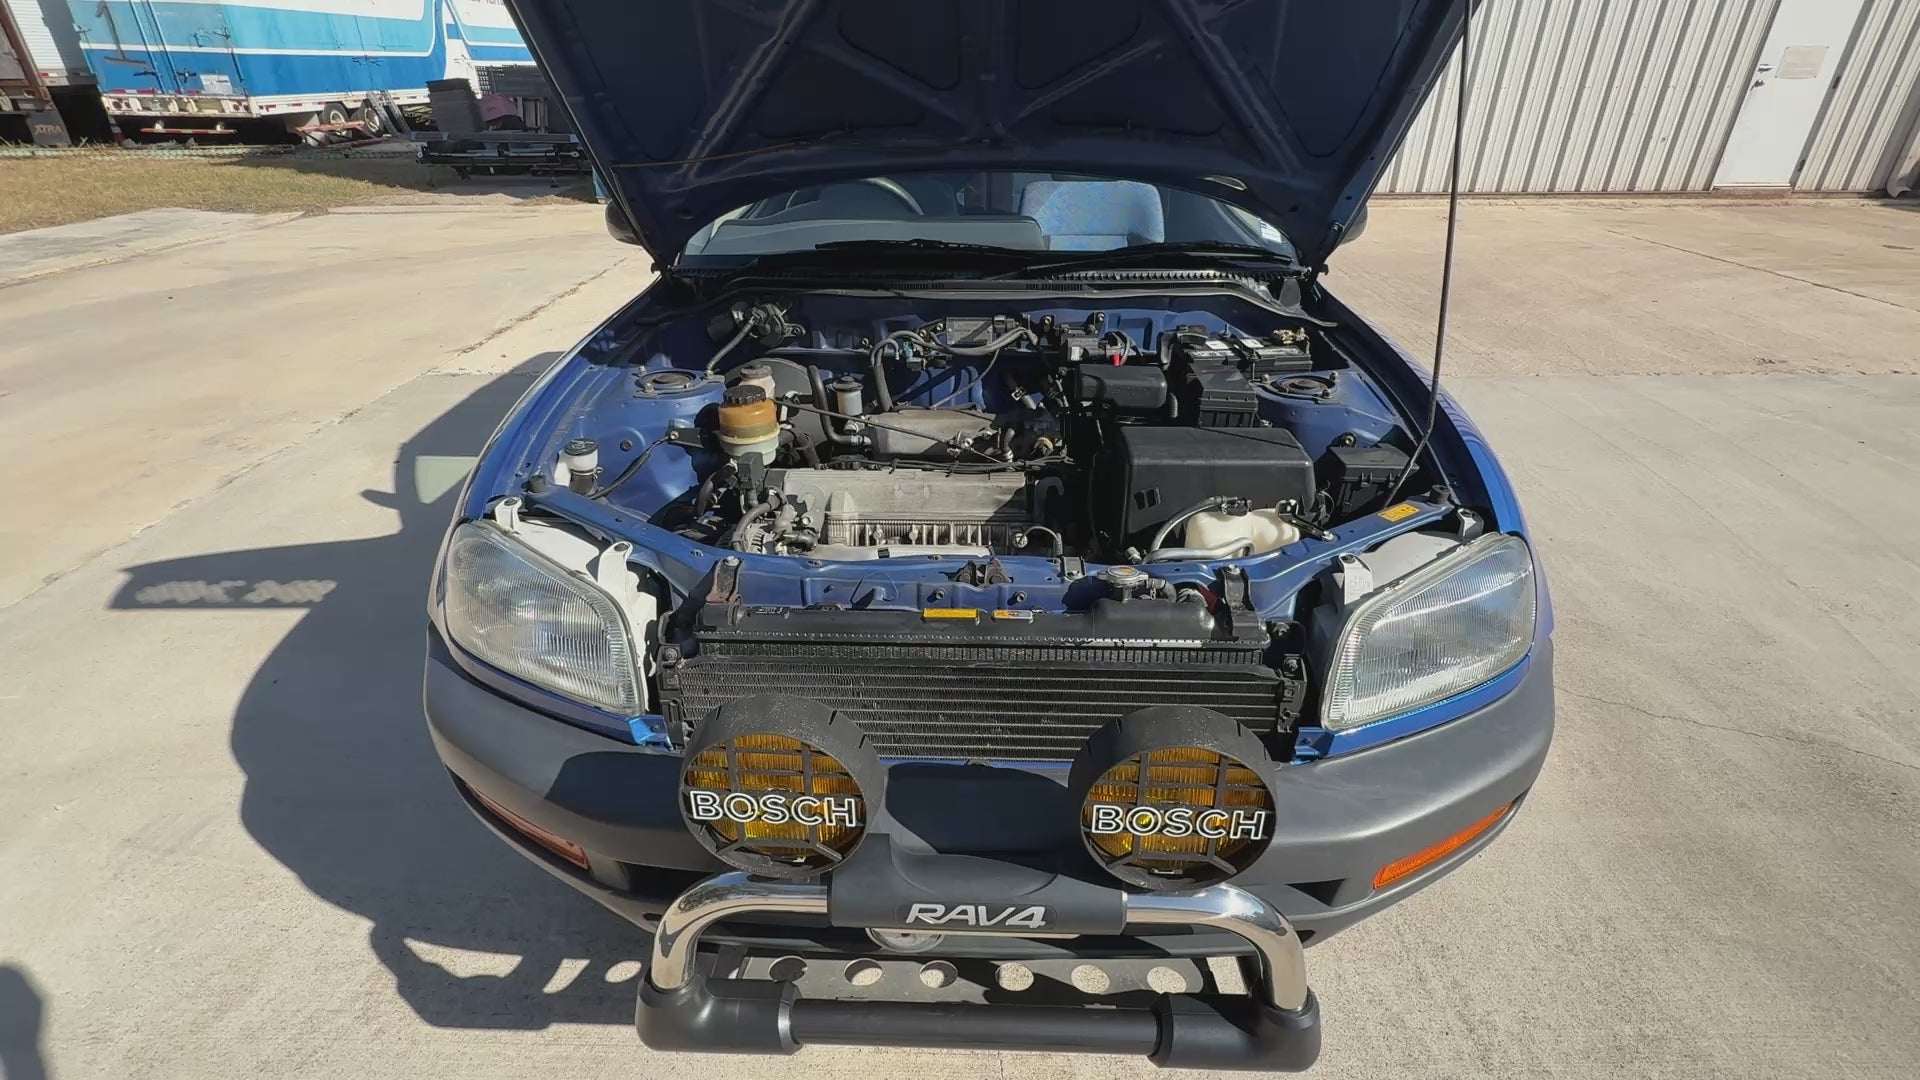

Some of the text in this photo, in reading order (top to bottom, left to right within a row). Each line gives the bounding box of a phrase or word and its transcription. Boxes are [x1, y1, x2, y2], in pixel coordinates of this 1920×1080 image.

[33, 123, 64, 136] XTRA
[690, 790, 857, 827] BOSCH
[1091, 804, 1266, 840] BOSCH
[905, 903, 1046, 929] RAV4
